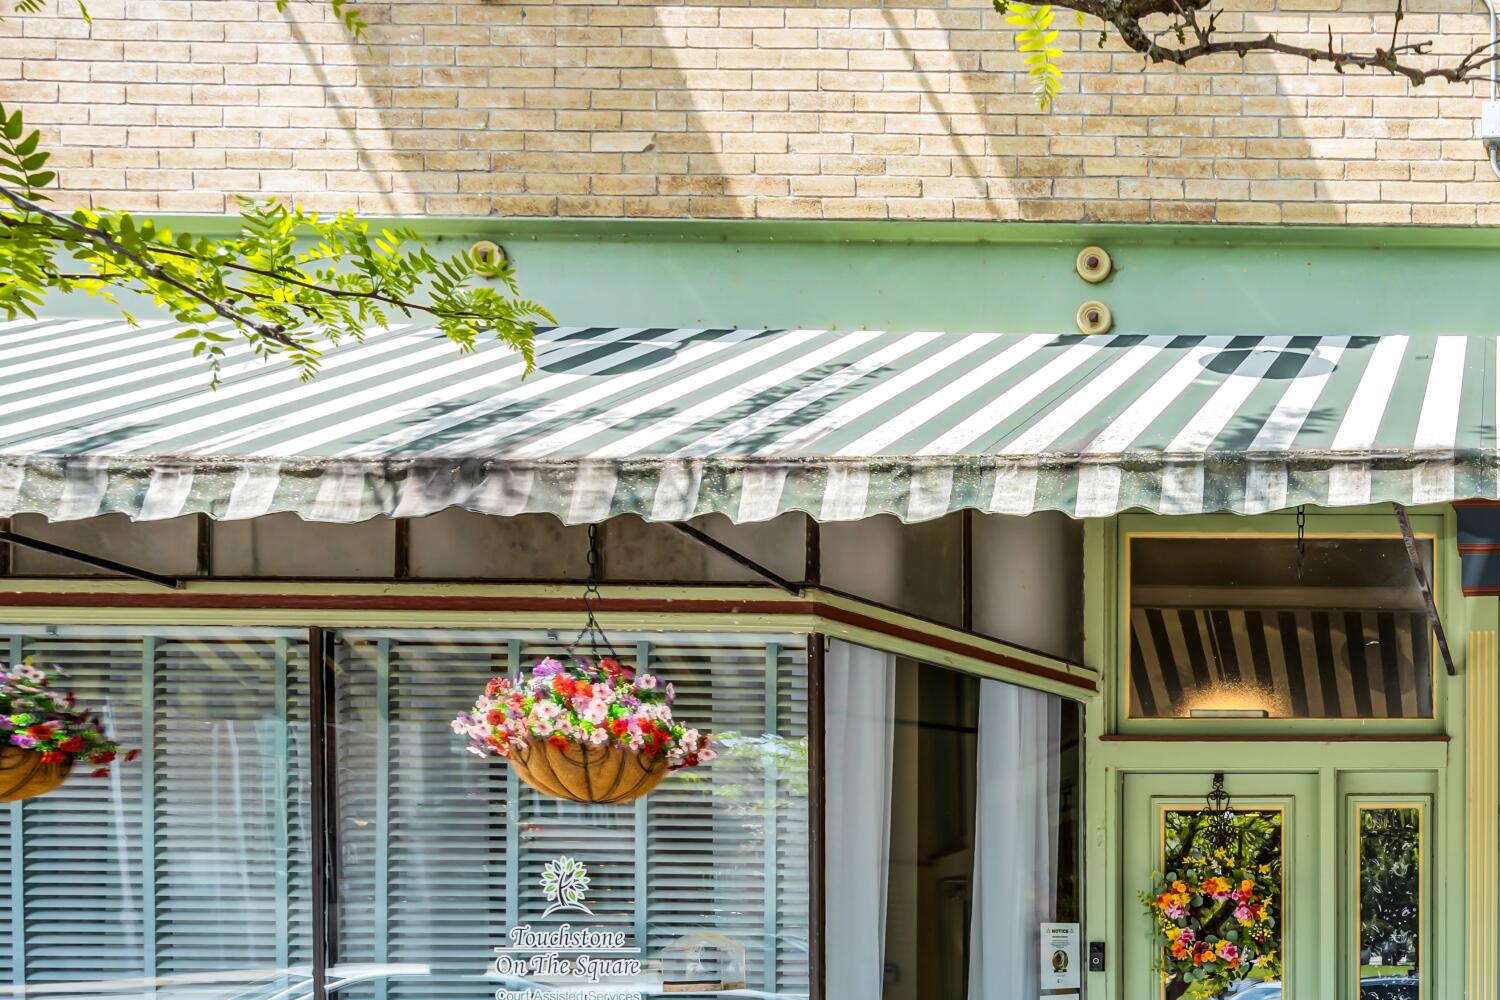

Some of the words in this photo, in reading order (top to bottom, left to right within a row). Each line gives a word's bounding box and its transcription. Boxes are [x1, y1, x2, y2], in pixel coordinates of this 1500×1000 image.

[511, 924, 625, 947] Touchstone
[496, 956, 526, 975] On
[531, 952, 570, 975] The
[574, 956, 640, 981] Square
